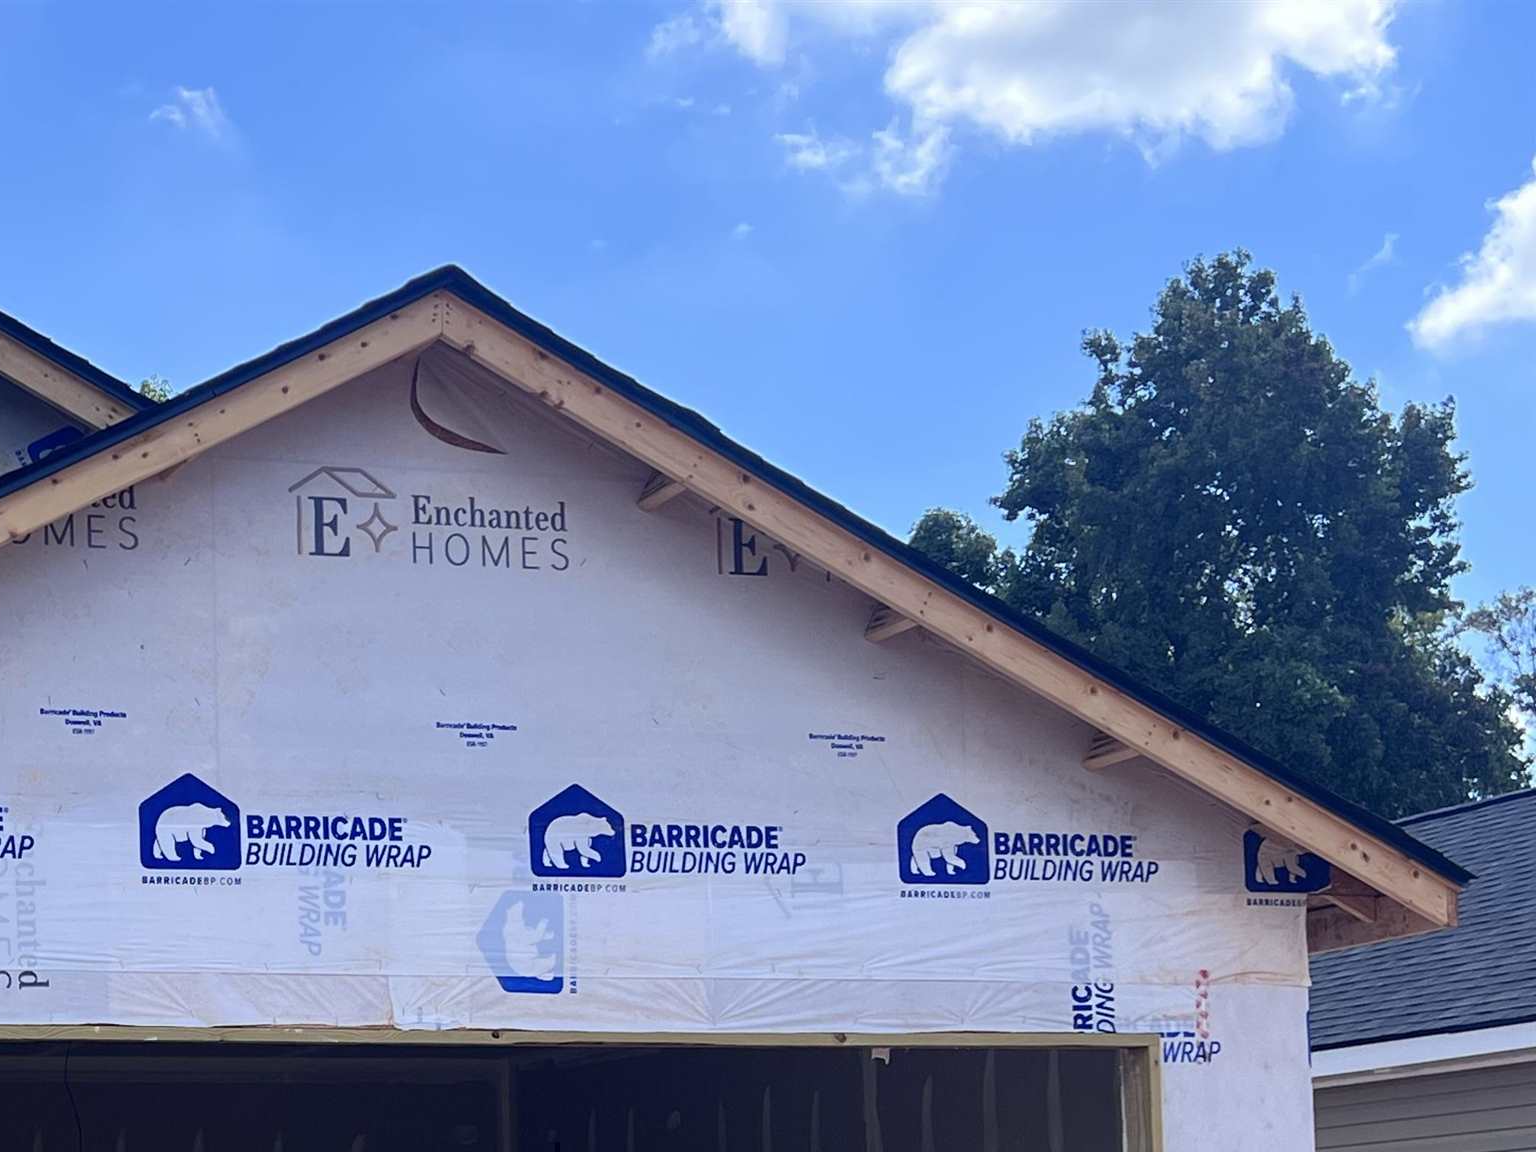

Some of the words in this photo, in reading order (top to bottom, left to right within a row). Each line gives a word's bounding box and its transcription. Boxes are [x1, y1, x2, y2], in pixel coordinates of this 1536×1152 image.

[411, 495, 568, 532] Enchanted
[12, 514, 139, 550] MES
[412, 532, 569, 571] HOMES
[247, 815, 403, 842] BARRICADE
[630, 824, 778, 850] BARRICADE
[245, 843, 357, 867] BUILDING
[365, 845, 432, 868] WRAP
[994, 833, 1134, 858] BARRICADE
[630, 851, 736, 875] BUILDING
[743, 852, 806, 875] WRAP
[993, 860, 1093, 882] BUILDING
[1101, 861, 1159, 884] WRAP
[141, 875, 242, 886] BARRICADEBP.COM
[532, 883, 626, 893] BARRICADEBP.COM
[1163, 1042, 1221, 1063] WRAP
